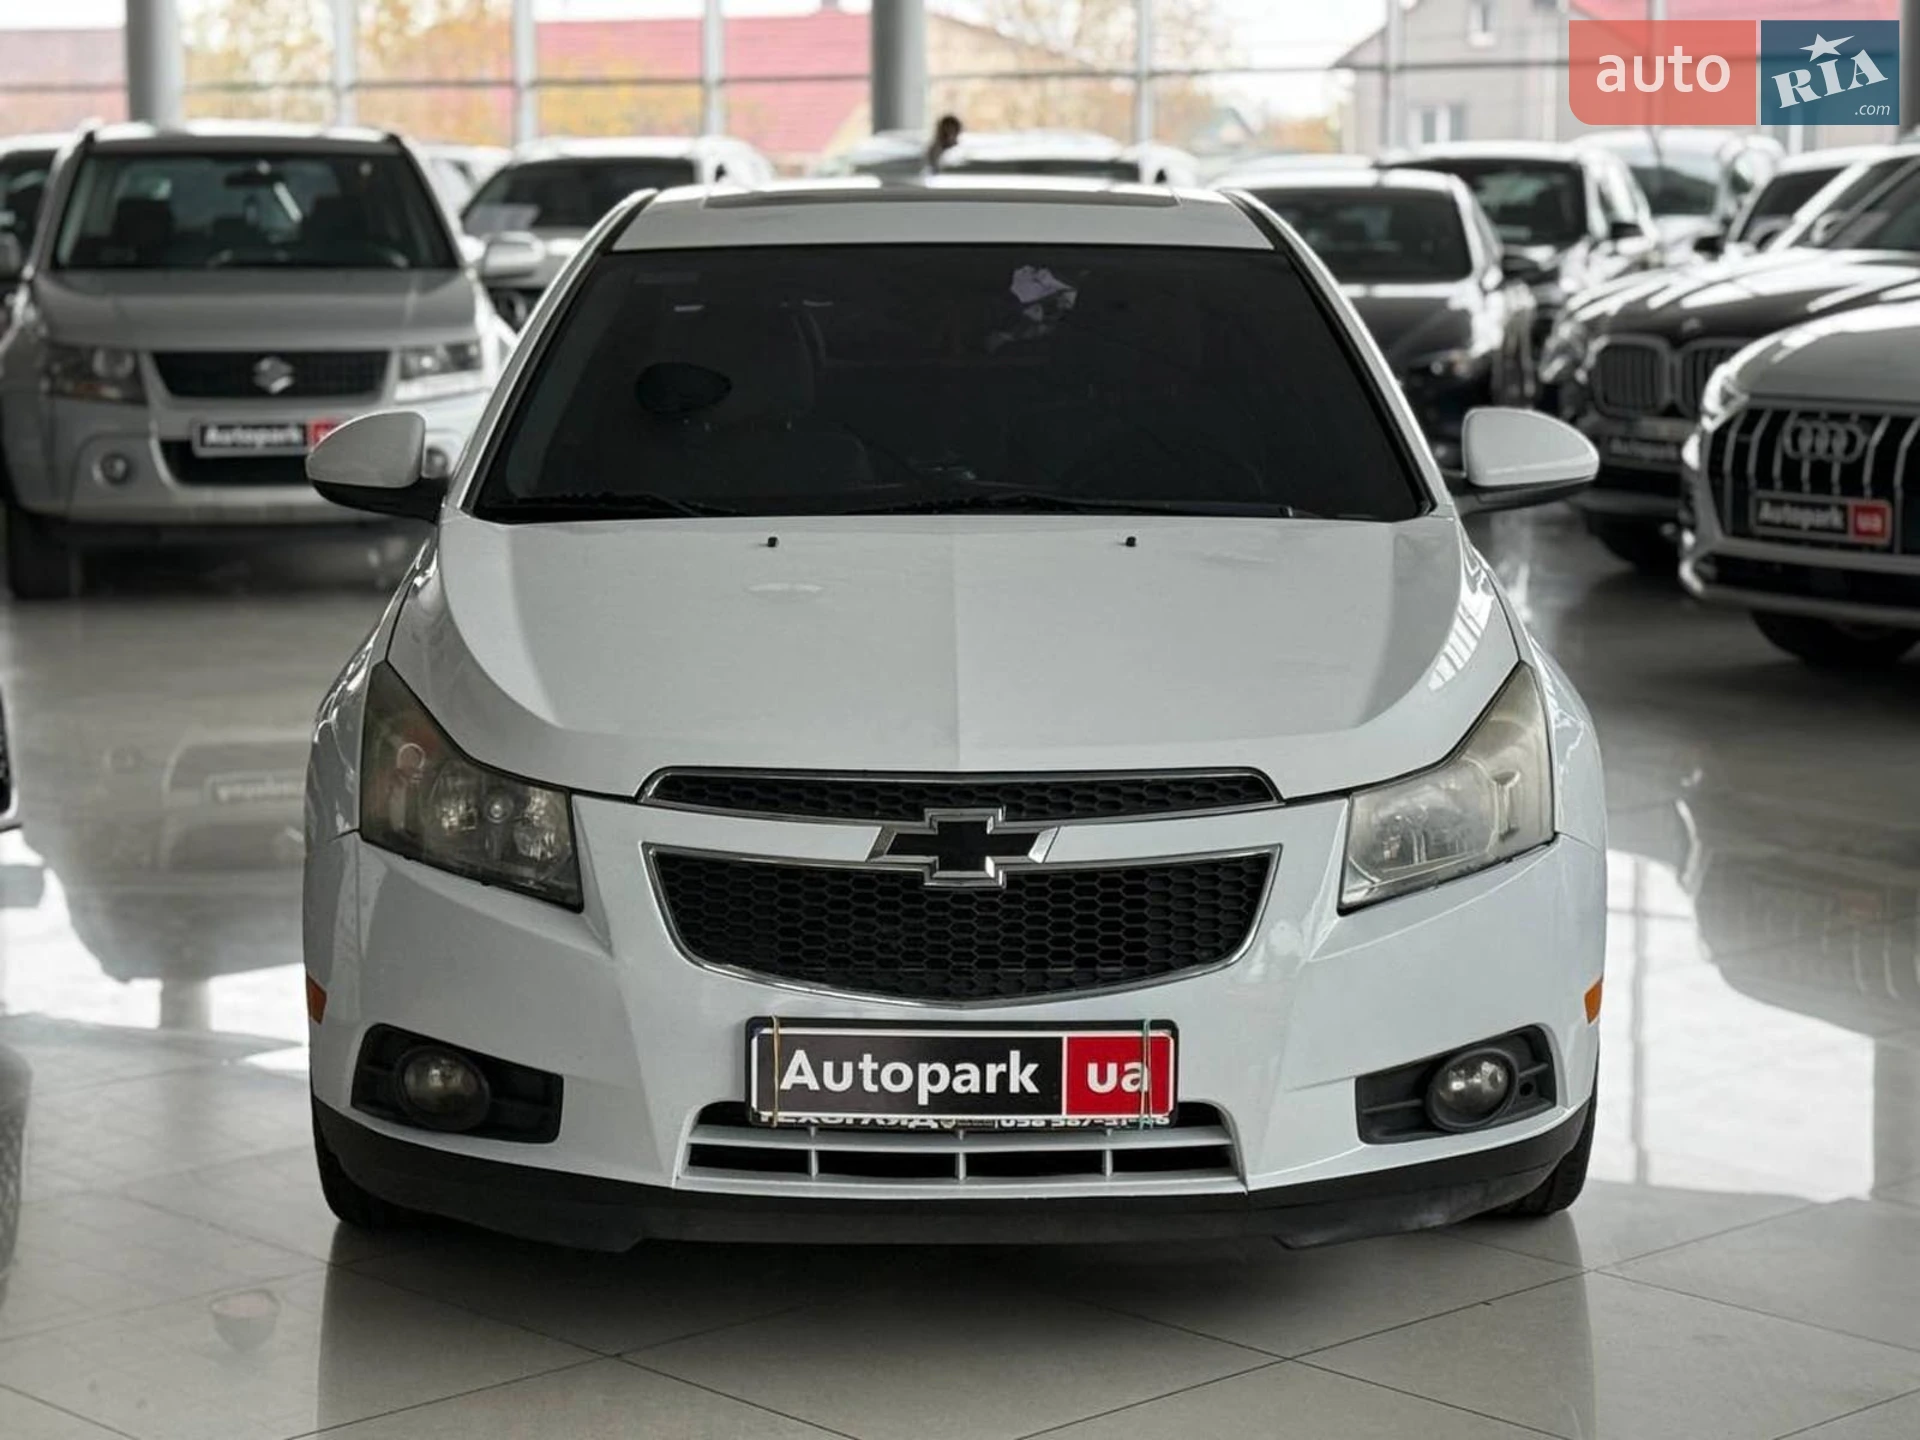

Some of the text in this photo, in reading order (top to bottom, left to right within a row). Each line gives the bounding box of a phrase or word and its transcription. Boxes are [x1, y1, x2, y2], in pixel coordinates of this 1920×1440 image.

[204, 425, 302, 450] Autopark
[1759, 500, 1844, 531] Autopark
[780, 1049, 1150, 1106] Autopark ua
